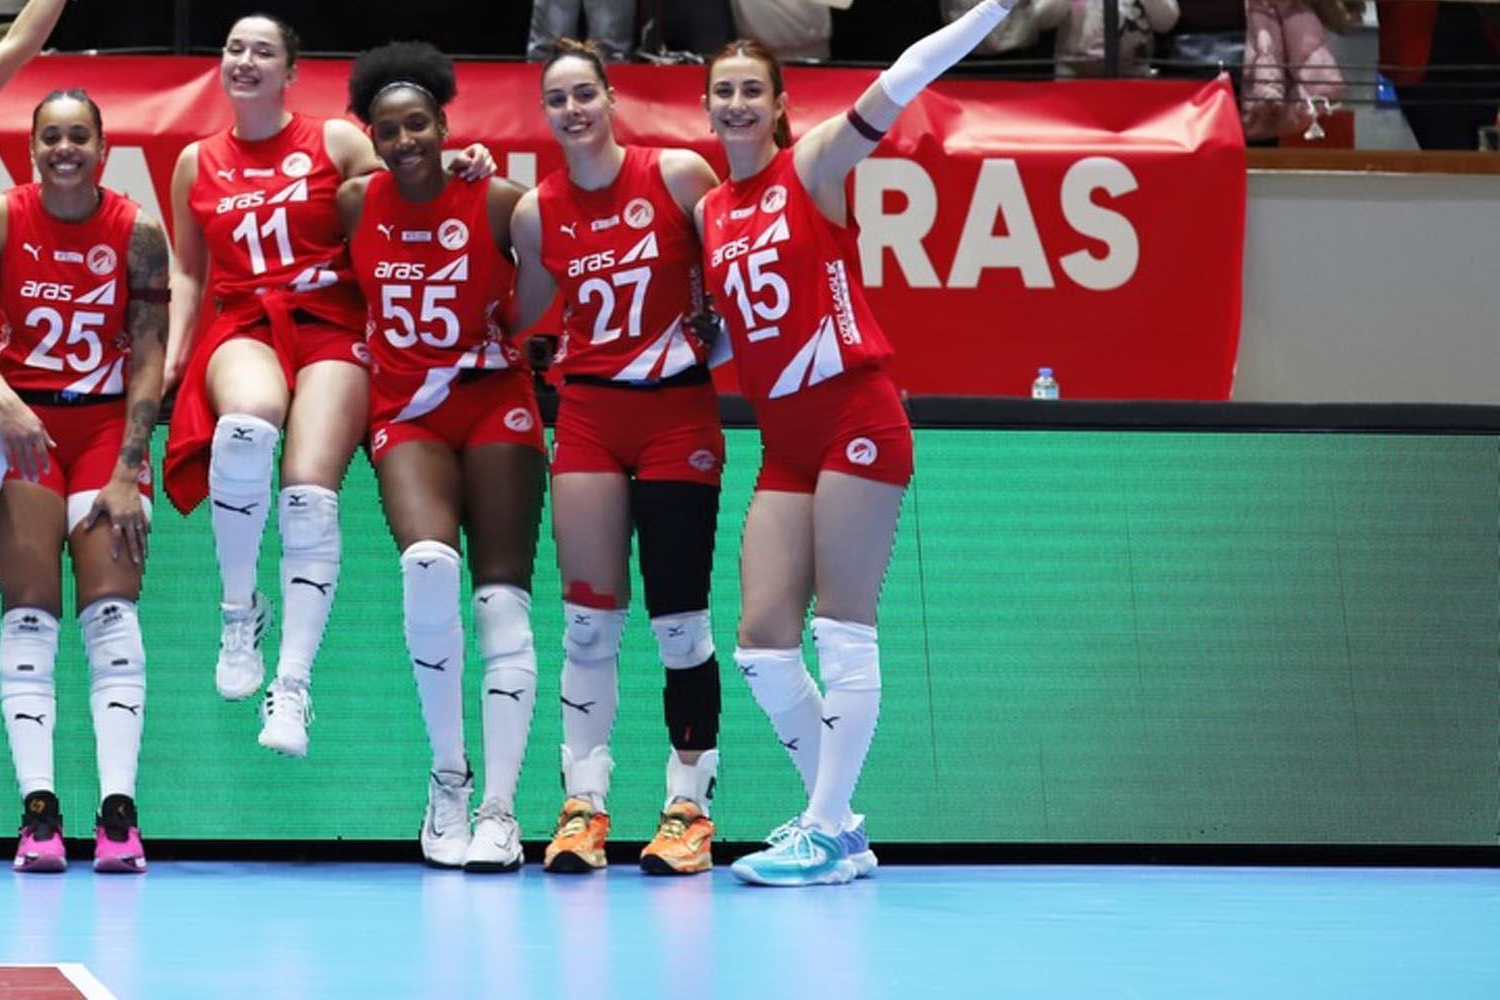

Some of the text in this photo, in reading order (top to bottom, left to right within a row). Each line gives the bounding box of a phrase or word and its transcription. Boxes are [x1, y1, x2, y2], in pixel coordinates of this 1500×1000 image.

[216, 190, 265, 214] aras
[232, 207, 295, 274] 11
[568, 250, 615, 277] aras
[711, 236, 750, 267] aras
[20, 280, 75, 301] aras
[375, 261, 426, 280] aras
[723, 249, 790, 330] 15
[381, 285, 460, 348] 55
[578, 266, 652, 345] 27
[24, 306, 105, 373] 25
